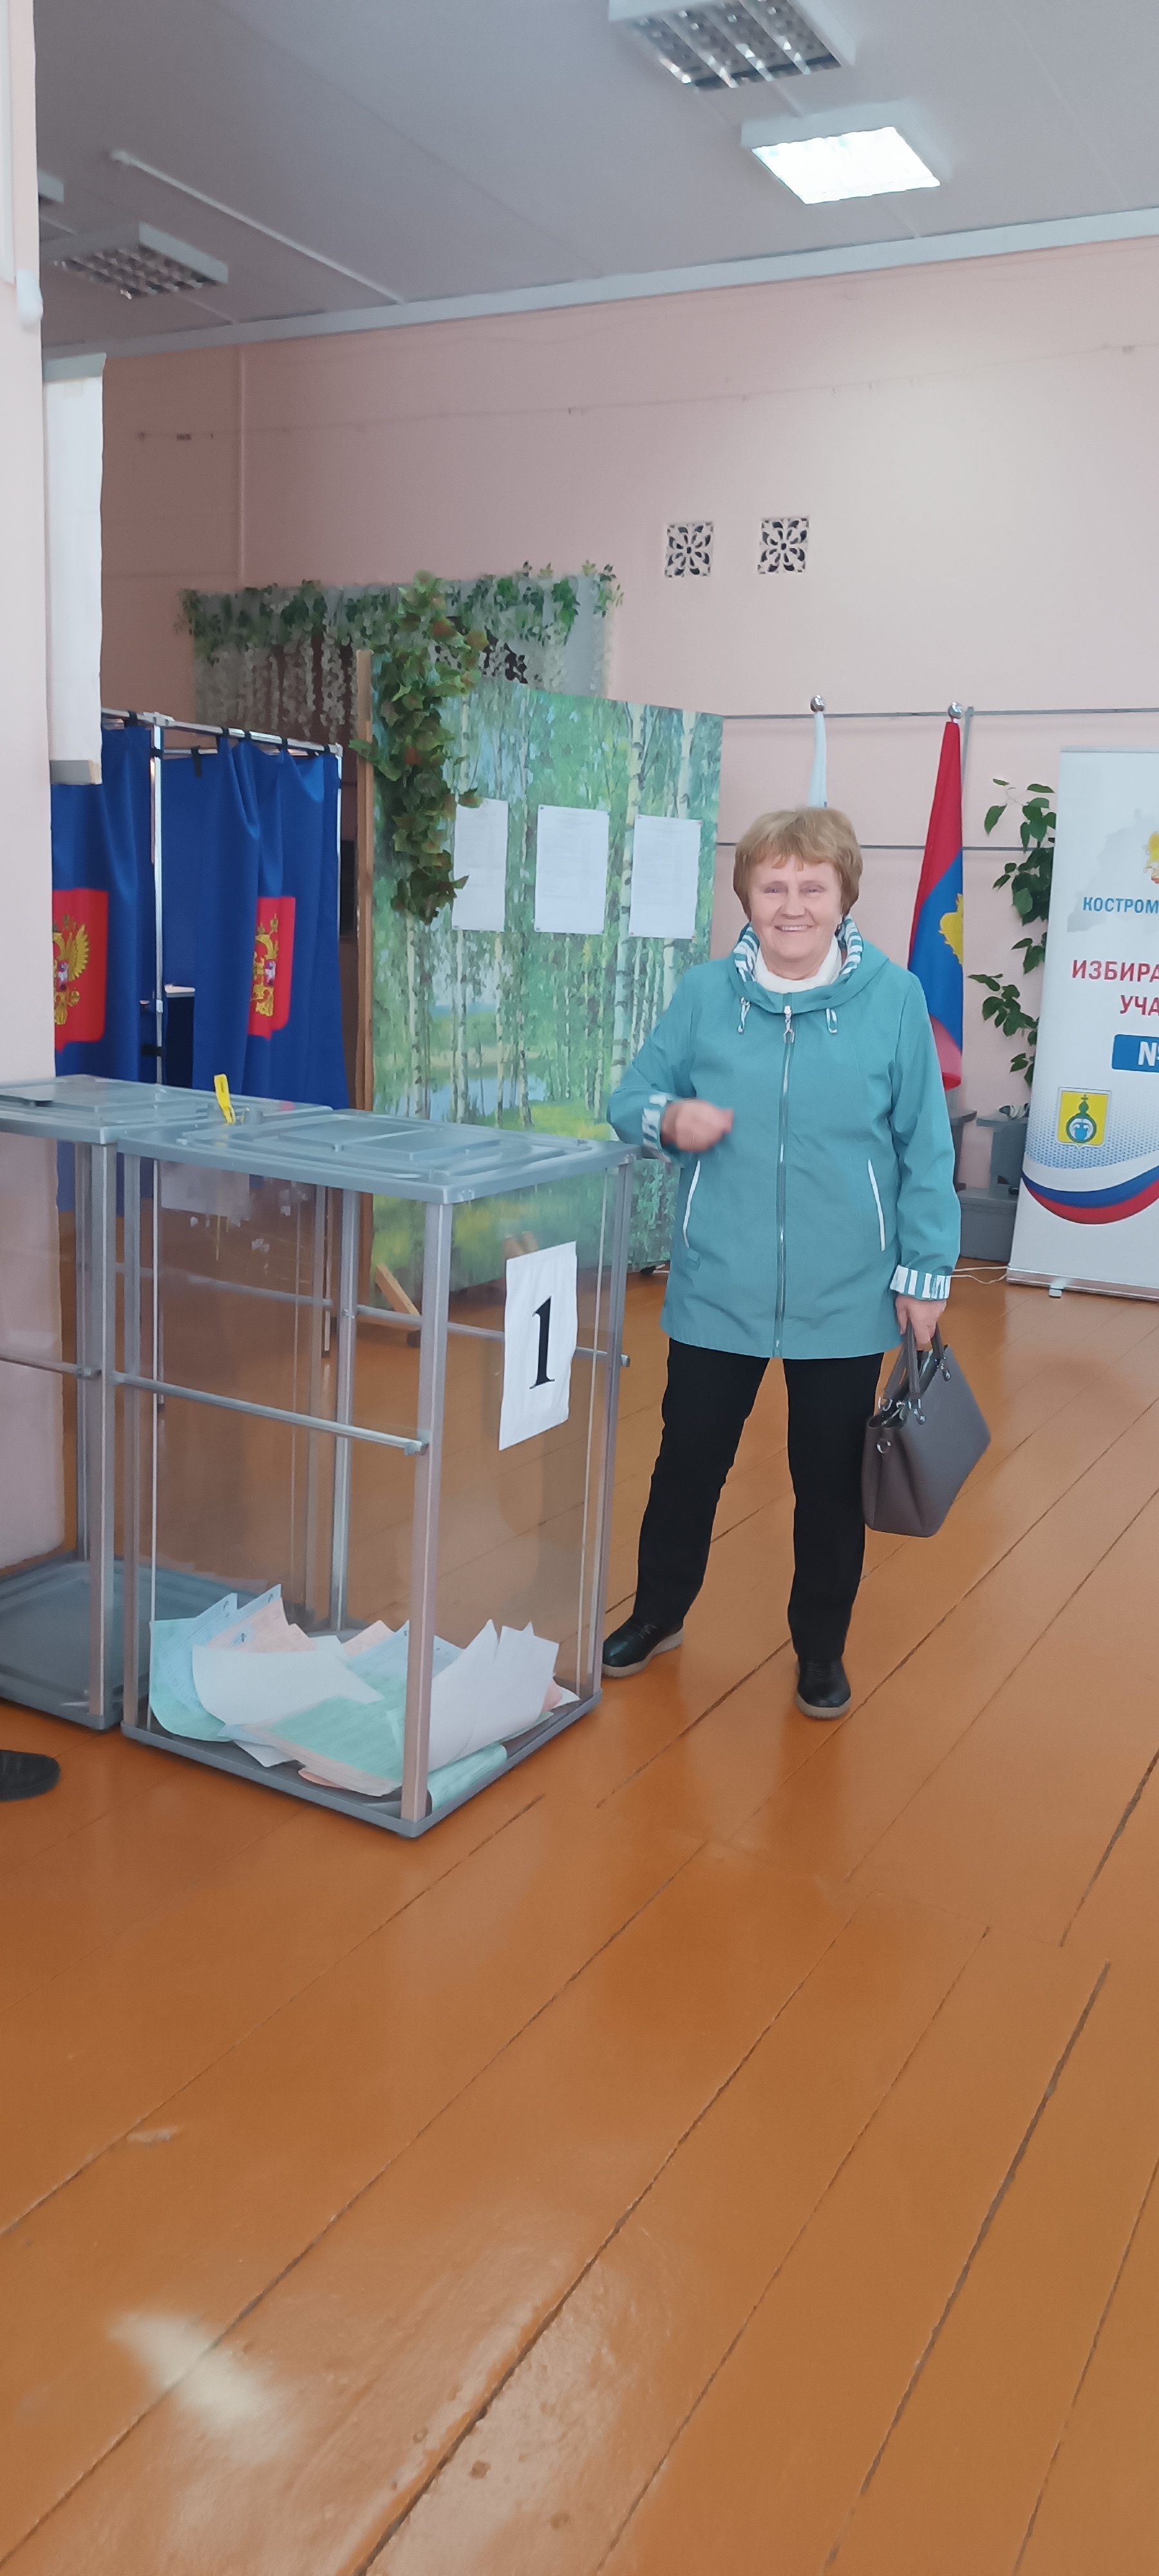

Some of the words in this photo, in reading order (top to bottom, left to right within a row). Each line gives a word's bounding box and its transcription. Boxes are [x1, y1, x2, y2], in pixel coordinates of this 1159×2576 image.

[1082, 896, 1159, 914] КОСТРОМ
[1072, 959, 1159, 983] ИЗБИРА
[1120, 994, 1159, 1016] УЧА
[529, 1295, 556, 1390] 1
